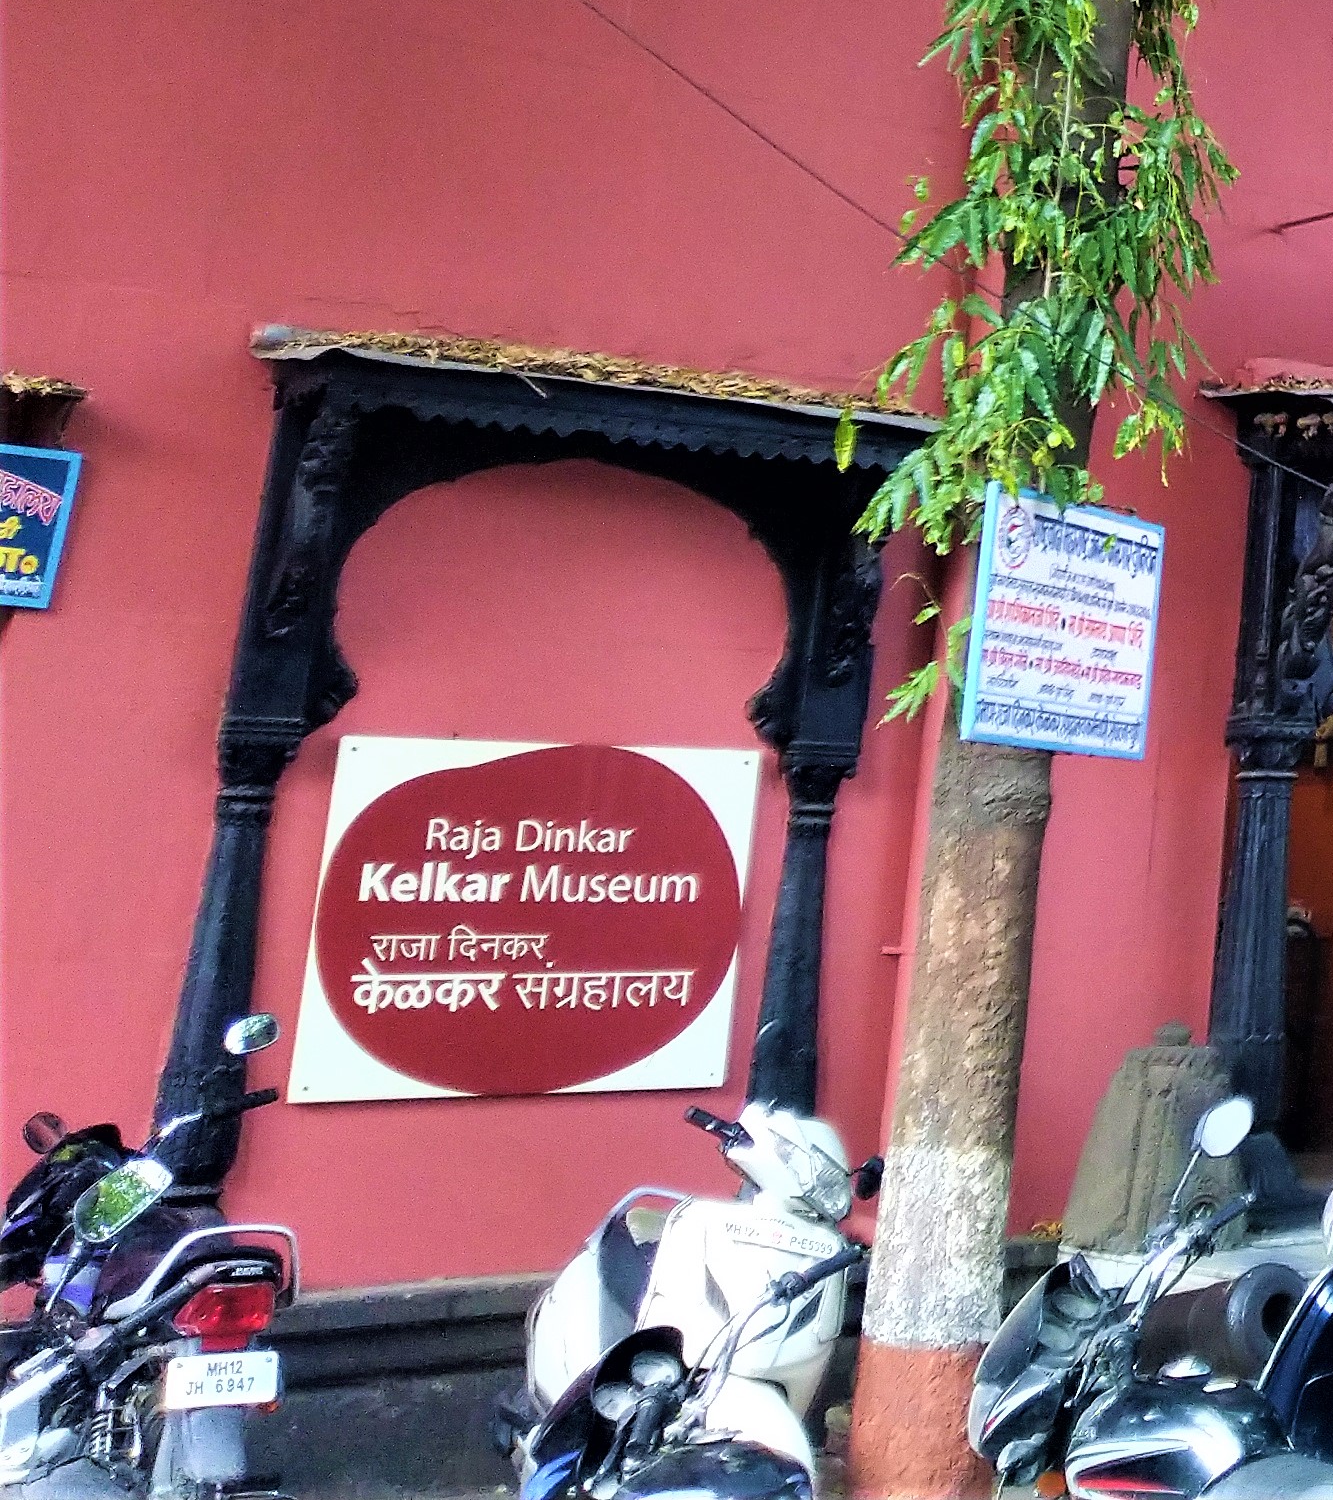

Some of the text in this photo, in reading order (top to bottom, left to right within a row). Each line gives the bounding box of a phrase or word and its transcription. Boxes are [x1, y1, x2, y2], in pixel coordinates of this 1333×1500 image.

[425, 818, 636, 860] Raja Dinkar
[358, 861, 700, 904] Kelkar Museum
[370, 924, 550, 963] राजा दिनकर
[351, 958, 696, 1014] केळकर संग्रहालय
[206, 1360, 243, 1377] MH12
